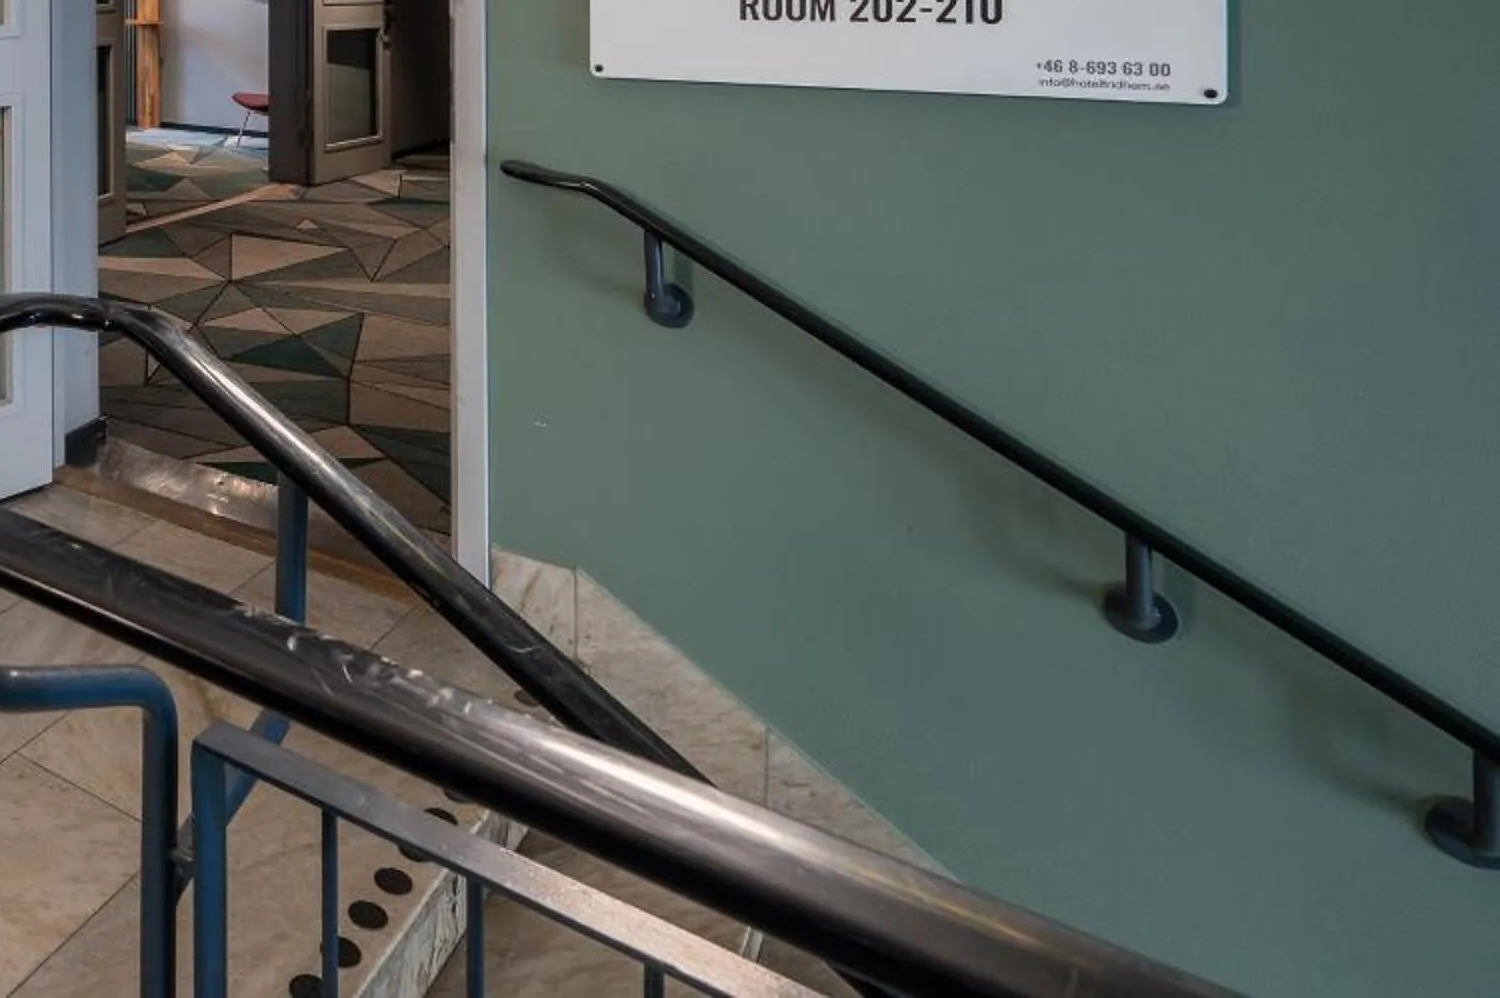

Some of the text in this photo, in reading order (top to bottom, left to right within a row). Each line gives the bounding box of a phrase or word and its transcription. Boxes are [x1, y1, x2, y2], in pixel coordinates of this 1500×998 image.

[1036, 59, 1172, 77] +46 8-693 63 00
